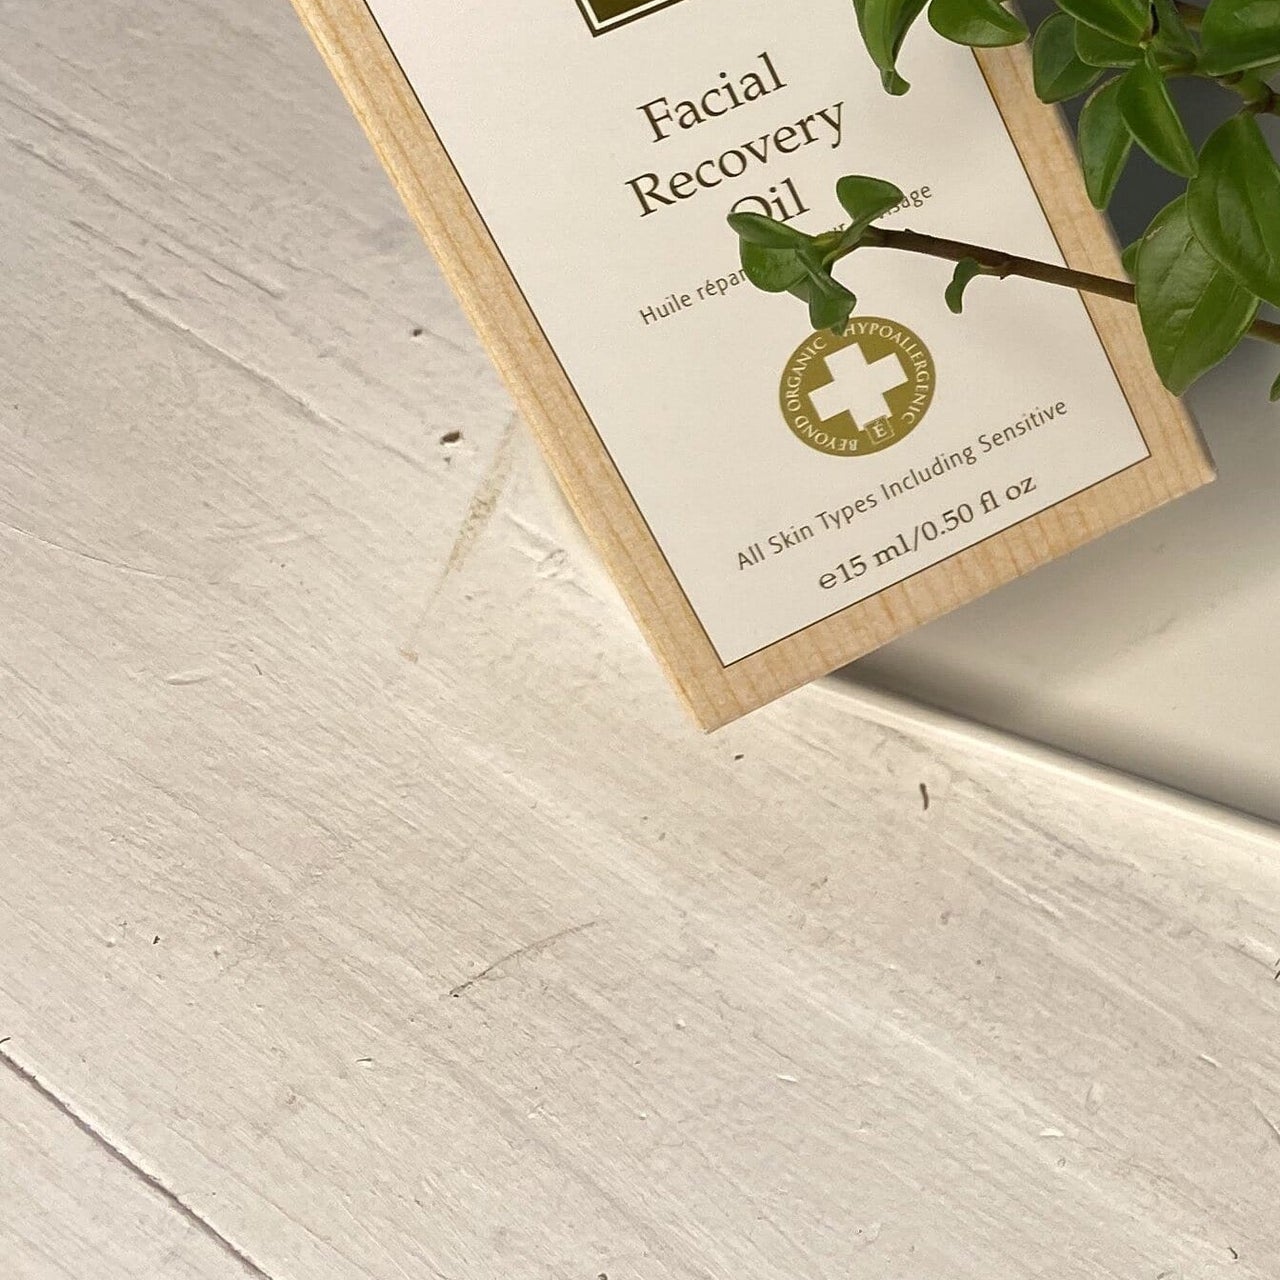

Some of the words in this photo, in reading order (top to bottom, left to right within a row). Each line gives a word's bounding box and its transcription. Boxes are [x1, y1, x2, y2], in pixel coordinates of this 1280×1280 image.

[636, 52, 788, 143] Facial
[624, 100, 847, 218] Recovery
[639, 291, 693, 325] Huile
[785, 336, 828, 412] ORGANIC
[843, 322, 931, 425] HYPOALLERGENIC
[794, 415, 858, 451] BEYOND
[737, 545, 765, 570] All
[768, 524, 815, 554] Skin
[815, 494, 878, 529] Types
[881, 445, 977, 500] Including
[978, 401, 1067, 453] Sensitive
[979, 490, 1000, 514] fl
[1005, 477, 1038, 501] oz
